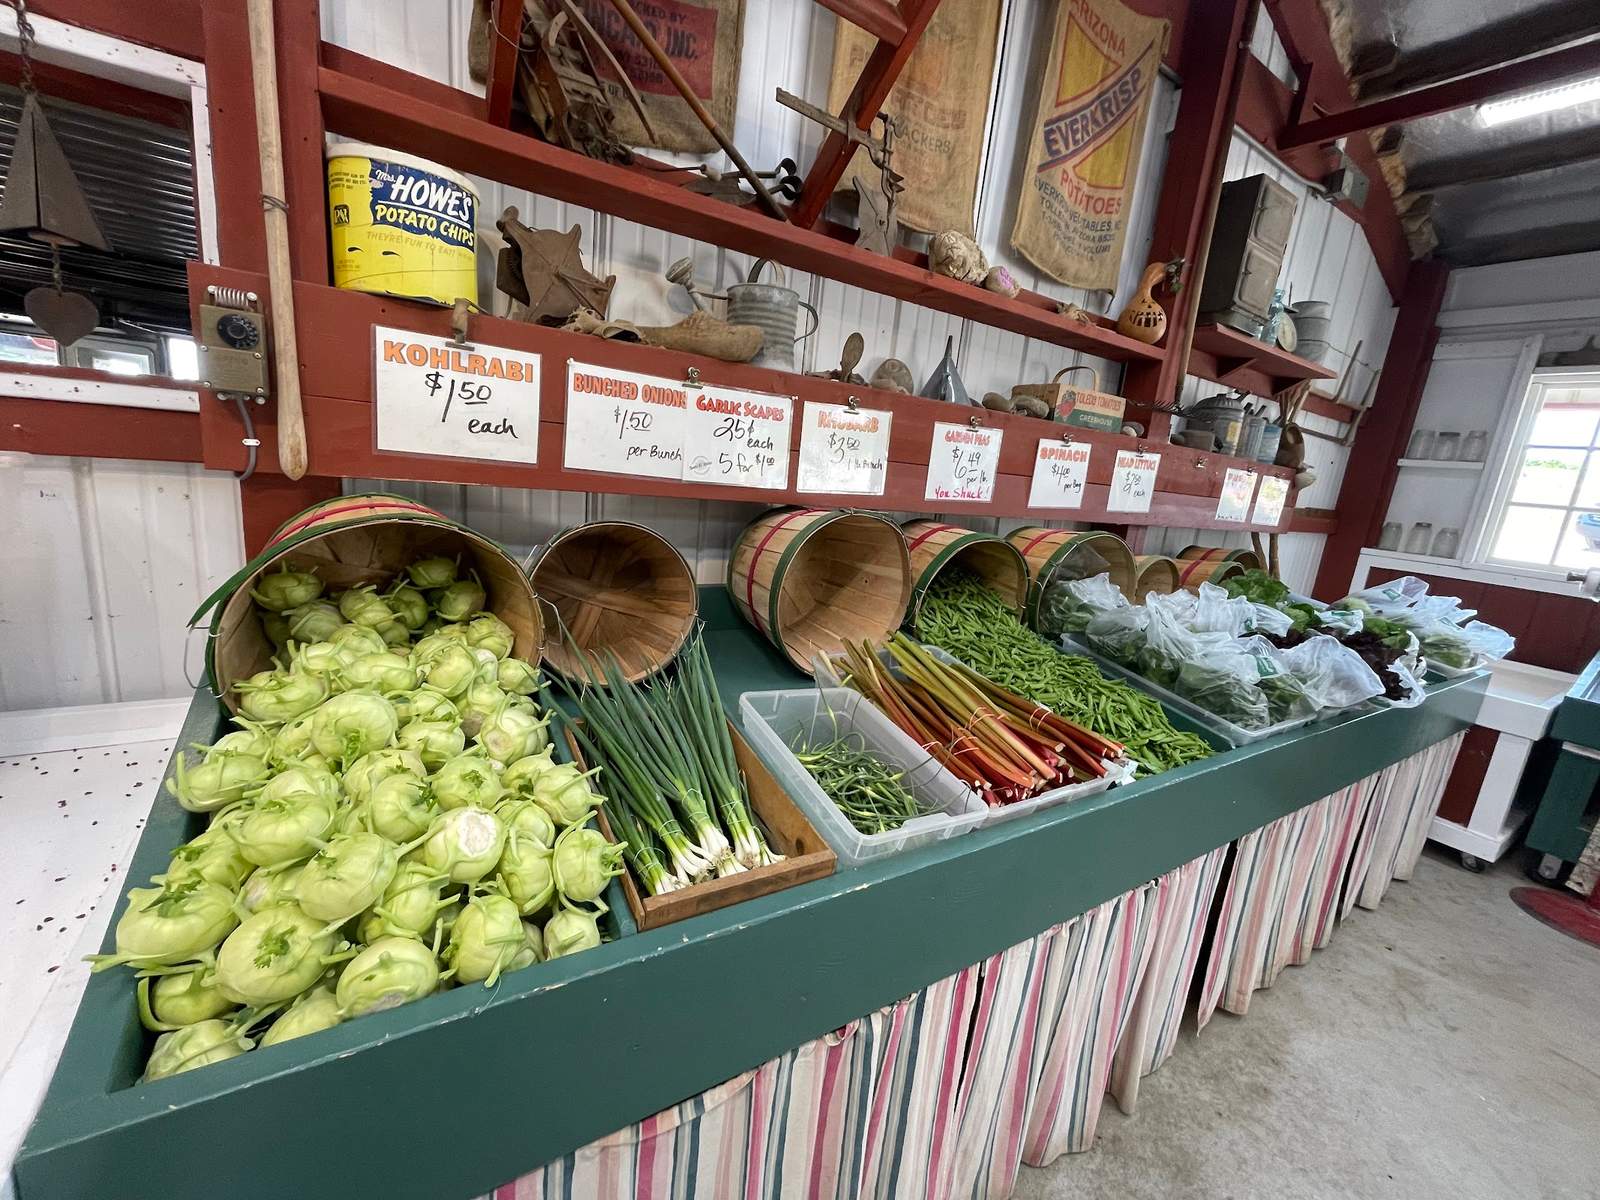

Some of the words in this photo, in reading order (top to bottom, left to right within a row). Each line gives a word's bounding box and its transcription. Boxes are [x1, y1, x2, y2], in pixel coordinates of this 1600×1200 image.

[1043, 67, 1142, 157] EVERKRISP
[898, 121, 952, 154] ACKERS
[375, 169, 397, 182] Mrs.
[390, 174, 472, 222] HOWE'S
[375, 204, 437, 232] POTATO
[440, 221, 475, 247] CHIPS
[383, 340, 534, 383] KOHLRABI
[573, 372, 638, 400] BUNCHED
[696, 394, 742, 416] GARLIC
[743, 401, 784, 421] SCAPES
[467, 418, 519, 439] each
[626, 446, 648, 460] per
[649, 445, 682, 460] Bunch
[747, 436, 774, 451] each
[1040, 447, 1088, 462] SPINACH
[718, 452, 733, 474] 5
[735, 452, 754, 472] for
[935, 485, 950, 499] You
[966, 477, 978, 488] per
